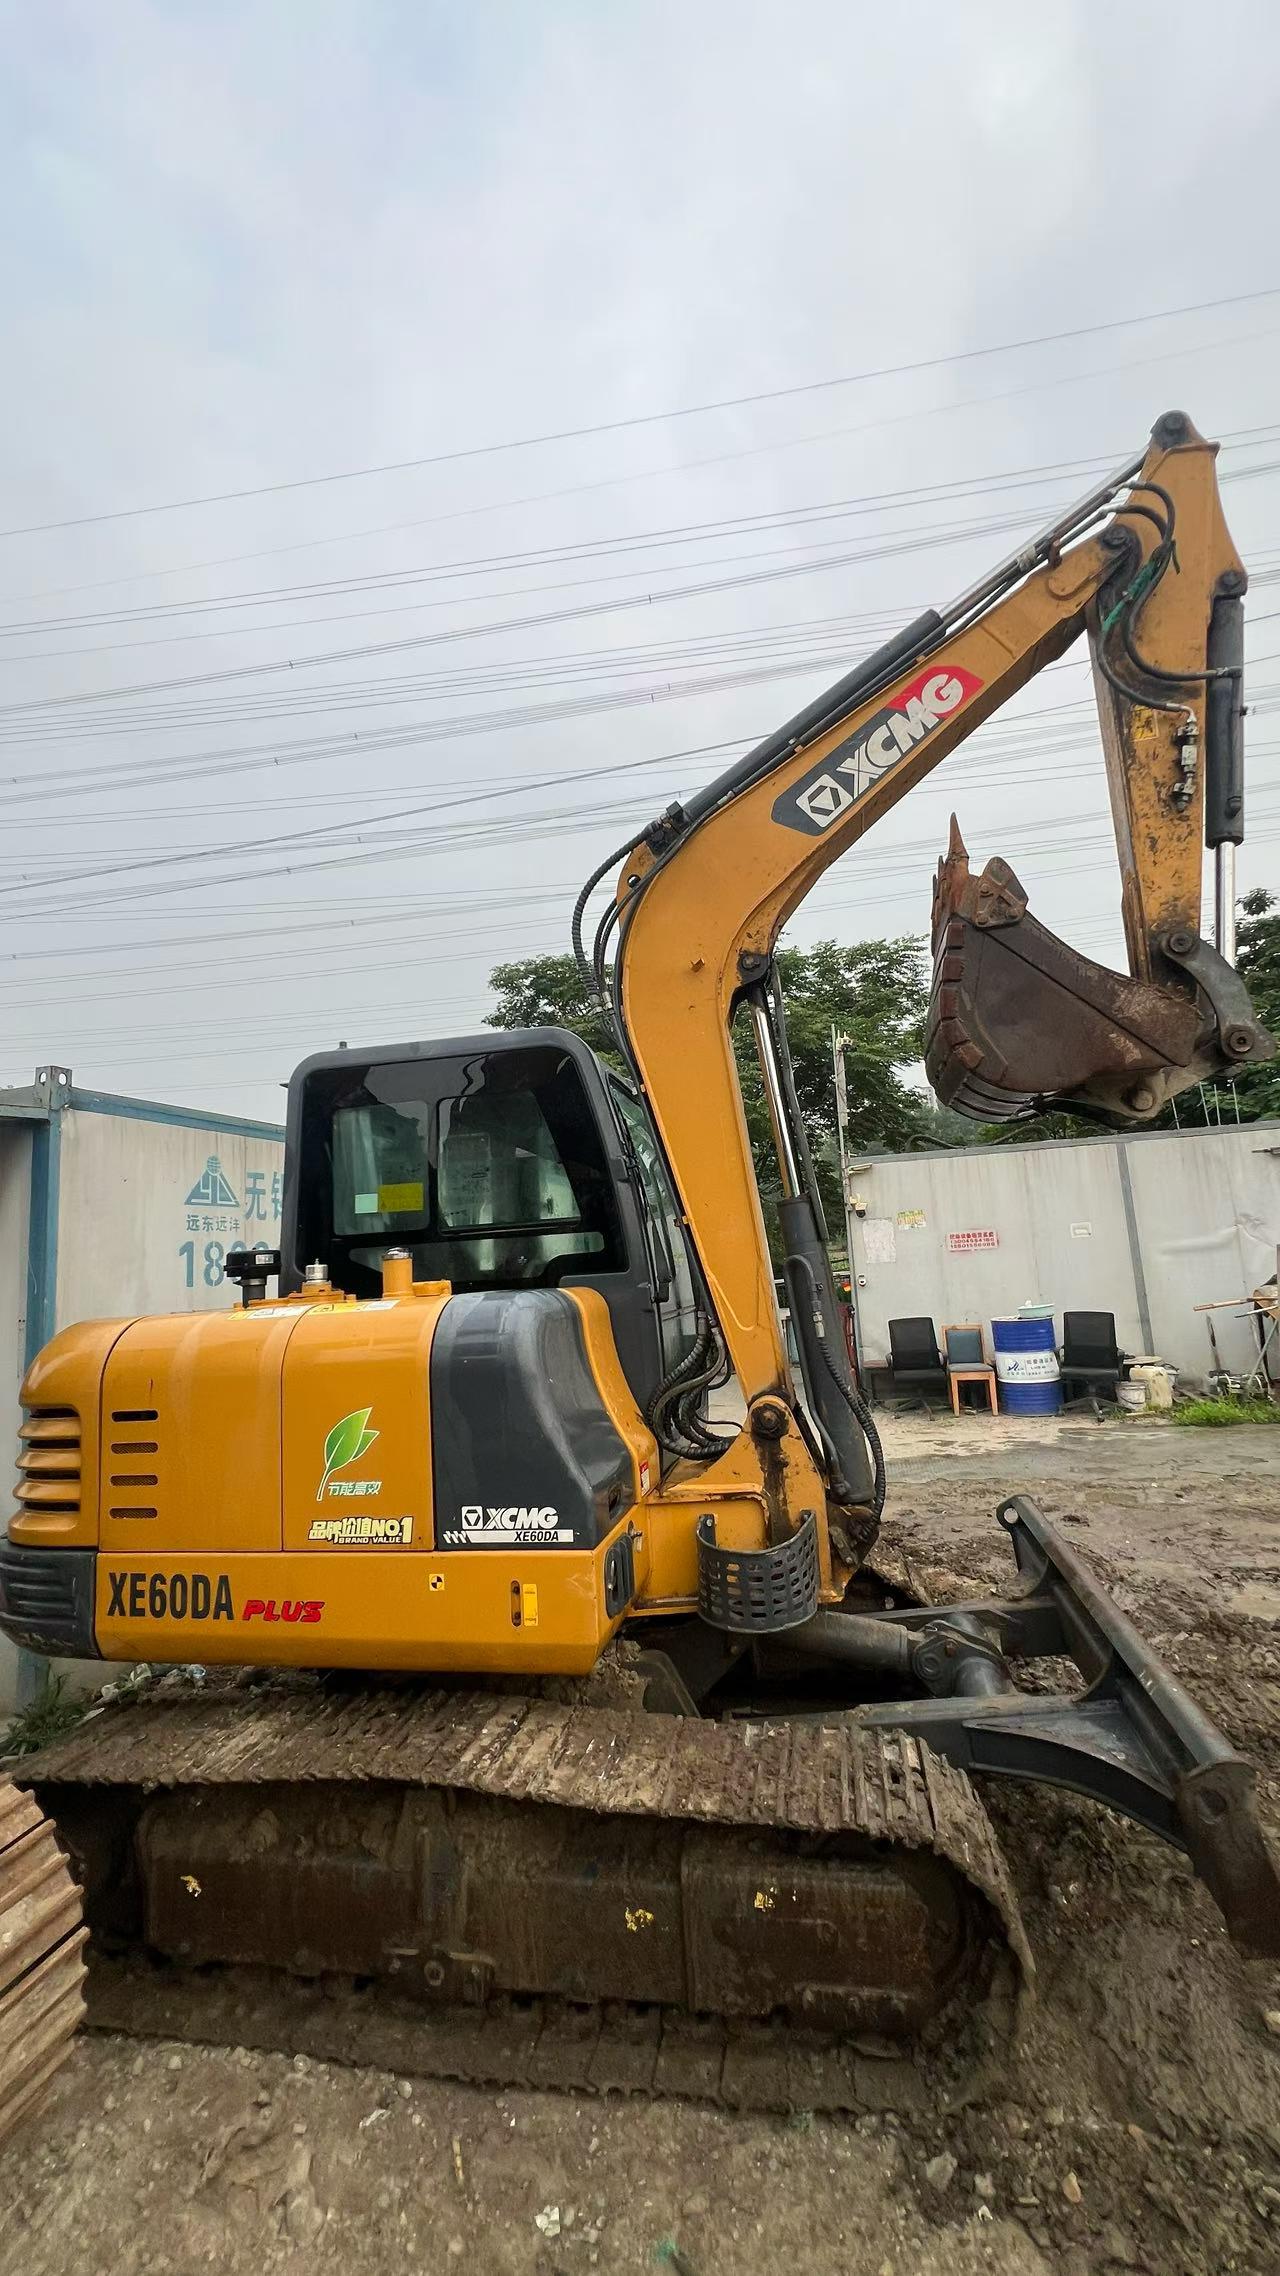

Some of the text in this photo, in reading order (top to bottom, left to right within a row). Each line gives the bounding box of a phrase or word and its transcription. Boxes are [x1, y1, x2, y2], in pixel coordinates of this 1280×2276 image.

[836, 673, 964, 799] XCMG
[186, 1214, 241, 1232] 远东远洋
[179, 1240, 270, 1287] 18
[328, 1481, 382, 1496] 节能高效
[483, 1507, 559, 1530] XCMG
[338, 1536, 402, 1544] BRAND VALUE
[514, 1531, 560, 1542] XE60DA
[107, 1572, 326, 1623] XE60DA PLUS
